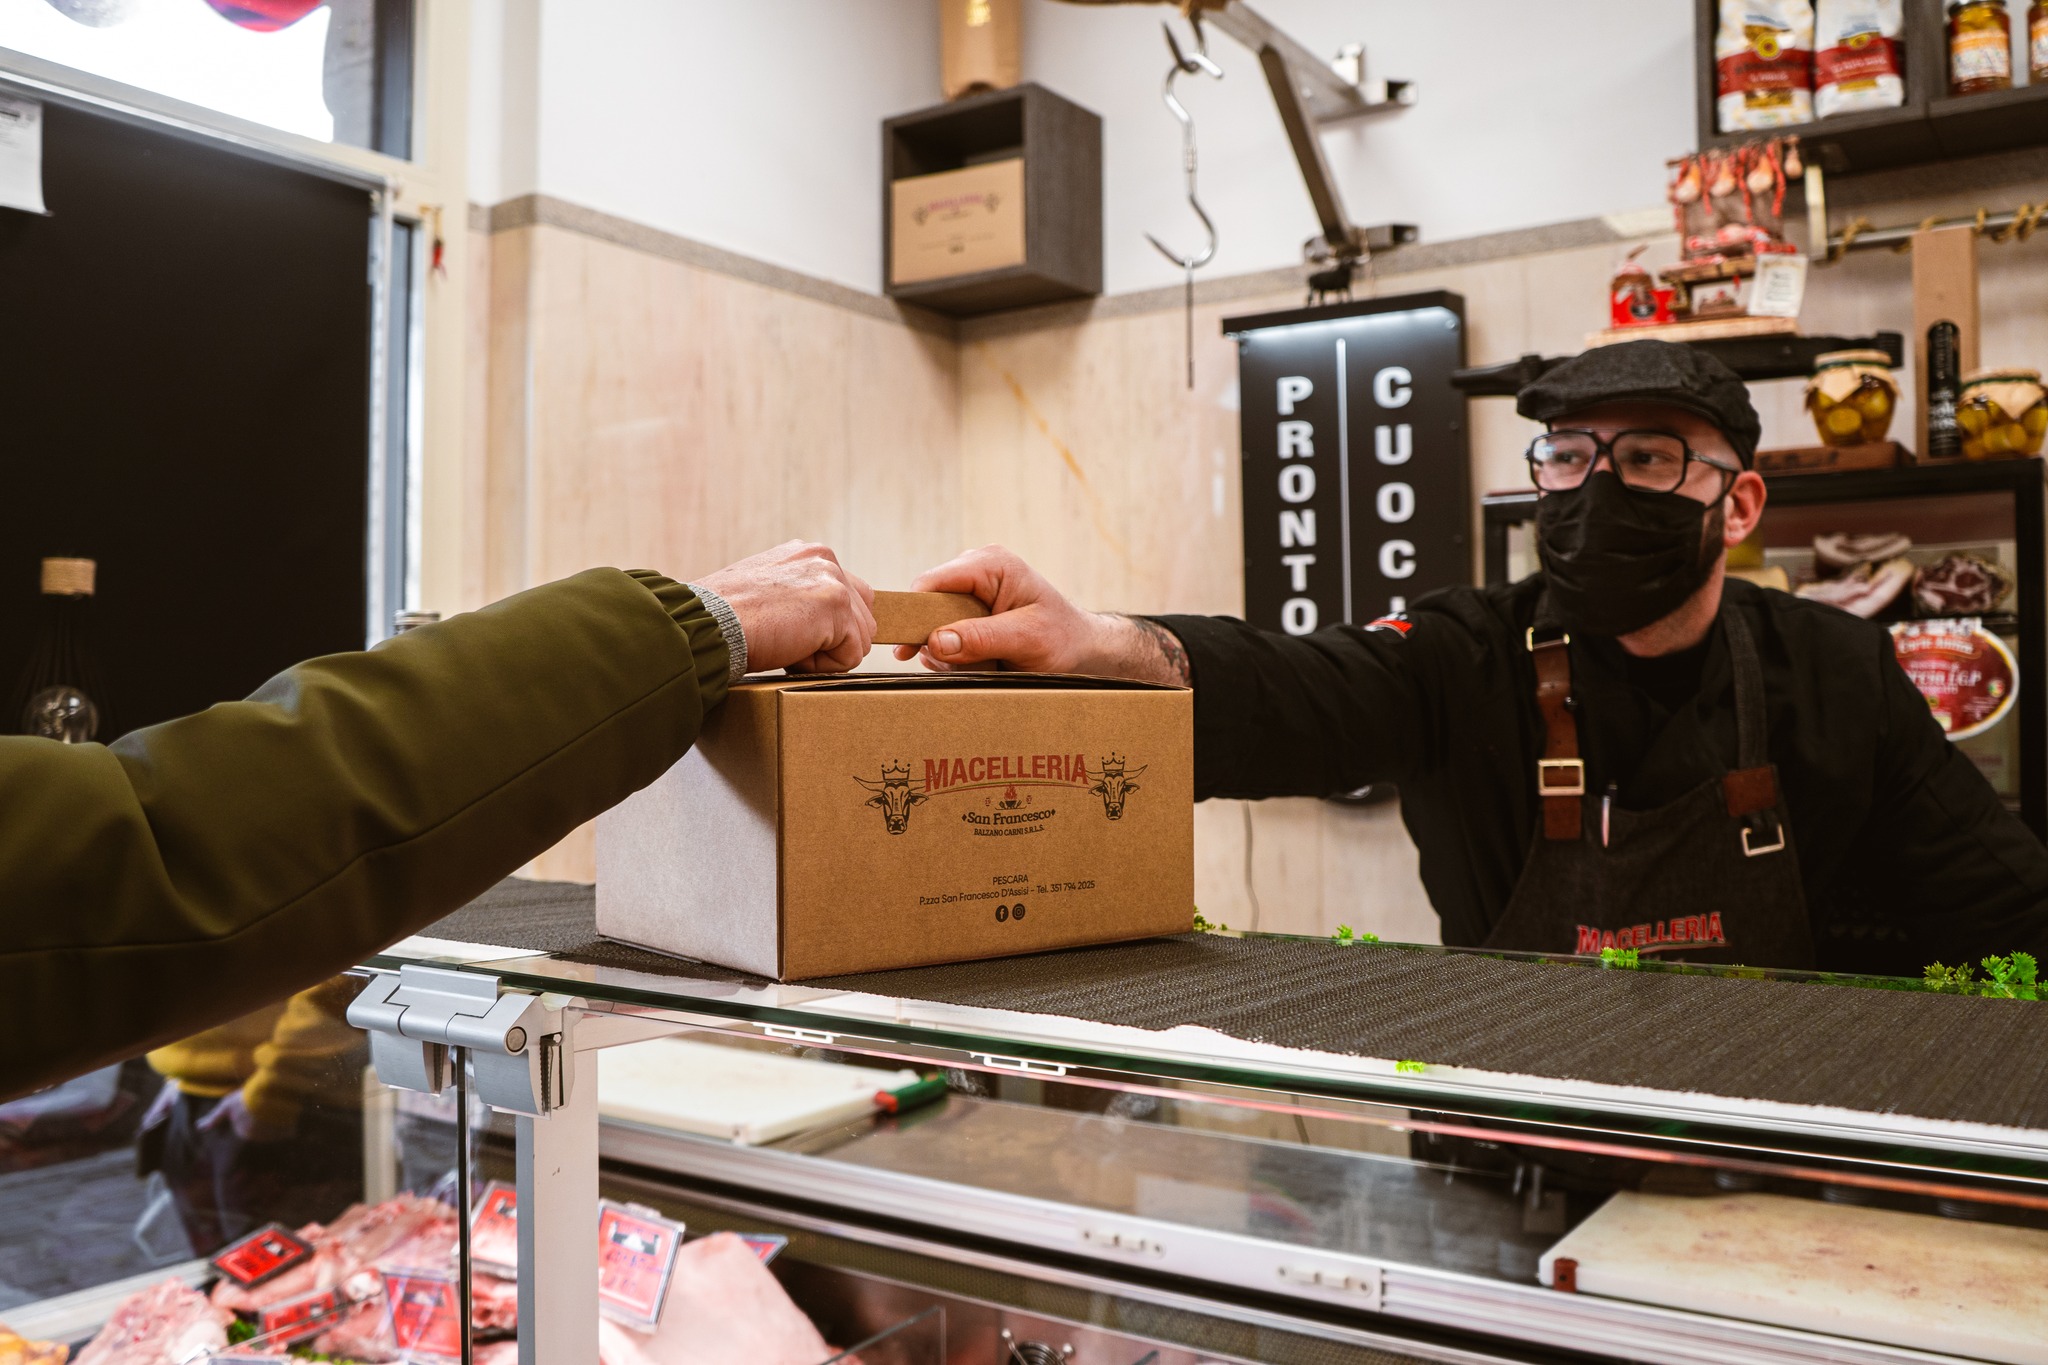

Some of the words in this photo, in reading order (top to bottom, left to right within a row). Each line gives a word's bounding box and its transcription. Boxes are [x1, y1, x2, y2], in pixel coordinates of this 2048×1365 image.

[1276, 375, 1318, 636] PRONTO
[923, 754, 1089, 793] MACELLERIA
[967, 812, 991, 825] San
[993, 809, 1051, 825] Francesco
[974, 828, 1003, 837] BALZANO
[1004, 828, 1023, 836] CARNI
[992, 874, 1029, 885] PESCARA
[920, 896, 940, 905] P.zza
[941, 894, 958, 904] San
[960, 891, 1000, 901] Francesco
[1001, 886, 1029, 897] D'Assisi
[1037, 885, 1048, 894] Tel.
[1050, 883, 1062, 892] 351
[1064, 882, 1076, 891] 794
[1077, 880, 1096, 890] 2025
[1575, 911, 1726, 954] MACELLERIA
